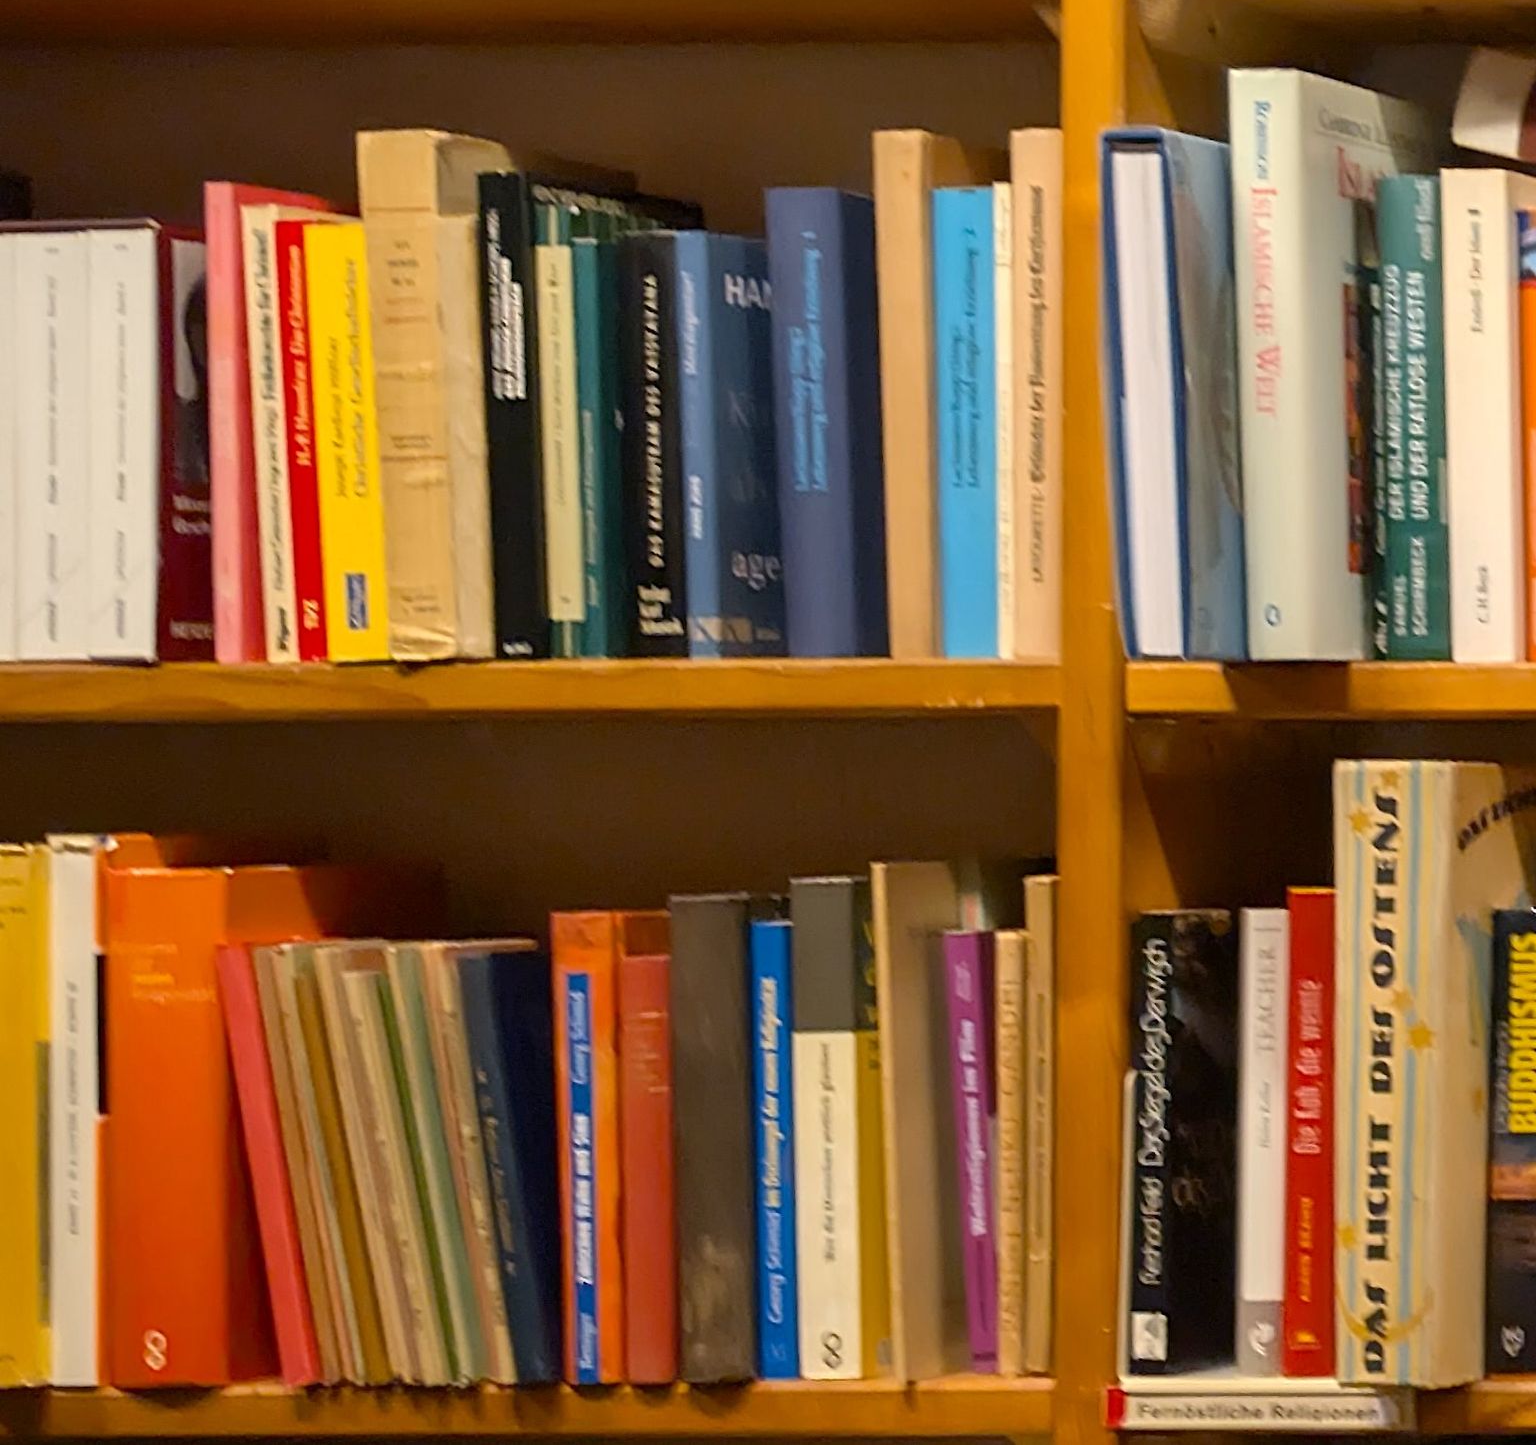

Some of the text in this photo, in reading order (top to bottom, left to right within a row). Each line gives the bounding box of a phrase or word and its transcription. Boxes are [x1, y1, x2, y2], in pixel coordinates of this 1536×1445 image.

[1363, 785, 1401, 1375] DAS LICHT DES OSTENS
